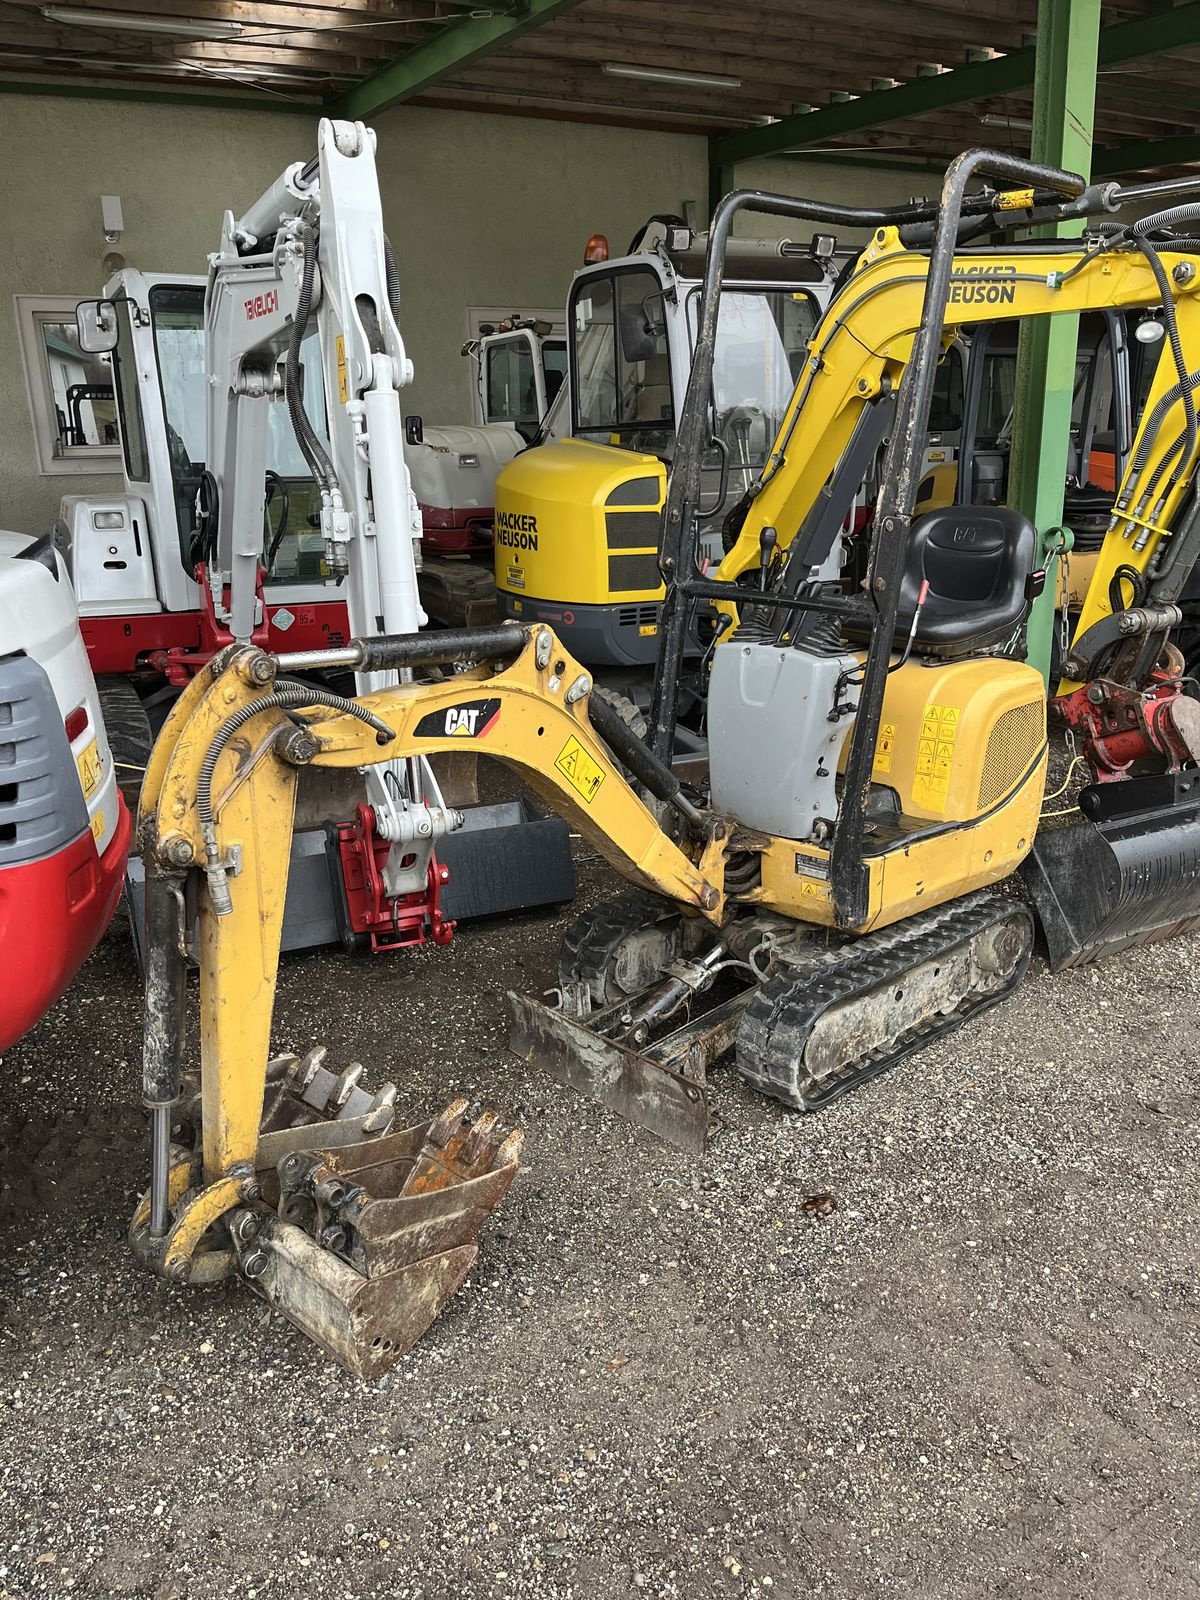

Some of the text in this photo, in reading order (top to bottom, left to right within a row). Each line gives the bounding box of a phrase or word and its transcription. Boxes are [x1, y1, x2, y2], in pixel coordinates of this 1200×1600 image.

[951, 266, 1017, 284] ACKER
[948, 286, 1015, 303] EUSON
[496, 511, 537, 533] WACKER
[497, 528, 538, 551] NEUSON
[445, 708, 479, 736] CAT
